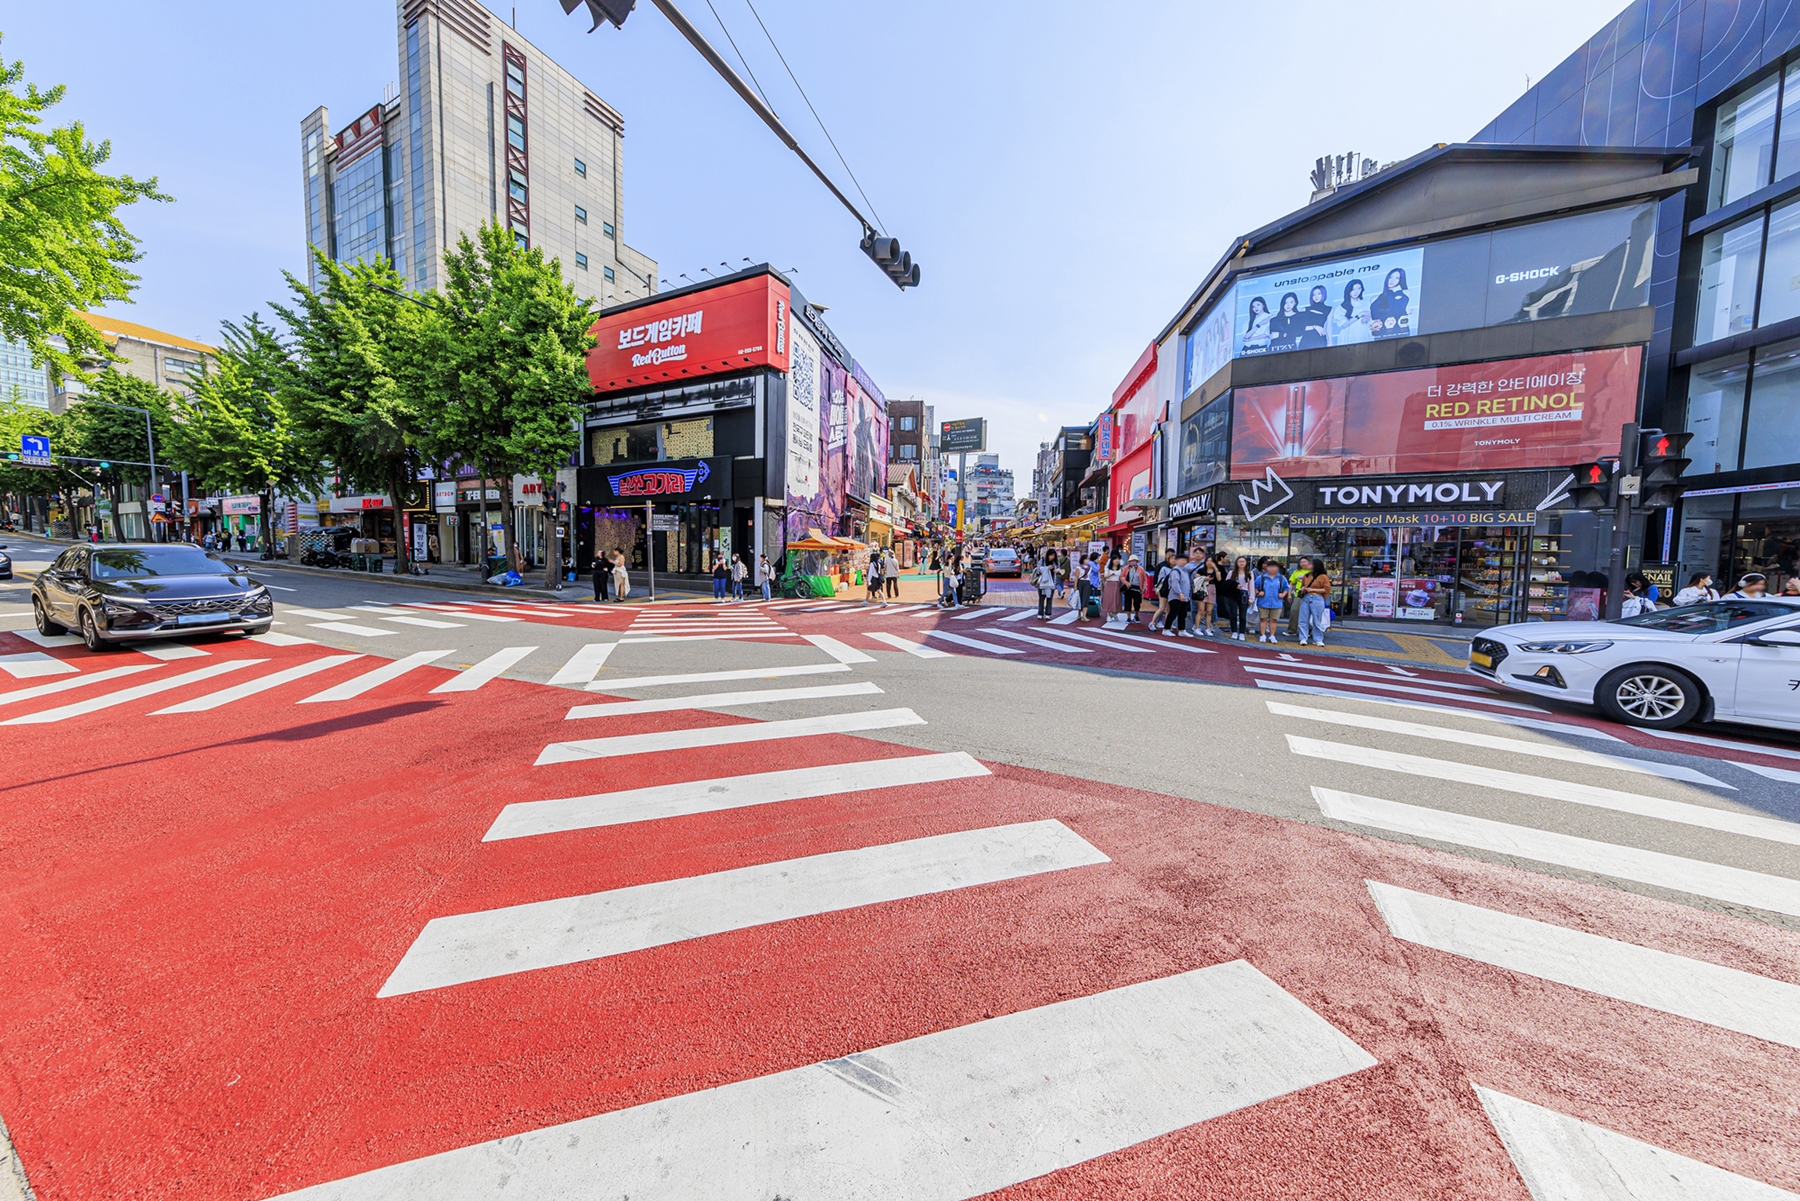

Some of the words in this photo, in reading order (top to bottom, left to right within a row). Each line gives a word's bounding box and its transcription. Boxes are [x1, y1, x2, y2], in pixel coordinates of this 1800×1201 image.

[1274, 268, 1355, 288] unstoppable
[1357, 263, 1381, 274] me
[1495, 266, 1560, 284] G-SHOCK
[617, 310, 704, 350] 보드게임카페
[1427, 384, 1442, 398] 더
[1446, 380, 1494, 397] 강력한
[1497, 371, 1583, 392] 안티에이징
[1425, 402, 1470, 418] RED
[1476, 392, 1583, 415] RETINOL
[1431, 420, 1452, 428] 0.1%
[1454, 417, 1498, 427] WRINKLE
[1500, 414, 1532, 424] MULTI
[1533, 411, 1572, 421] CREAM
[1474, 438, 1521, 446] TONYMOLY
[619, 472, 685, 496] 날쏘고가라
[1319, 481, 1504, 505] TONYMOLY
[1169, 493, 1210, 517] TONYMOLY
[1291, 514, 1319, 525] Snail
[1321, 514, 1382, 527] Hydro-gel
[1385, 514, 1419, 524] Mask
[1423, 513, 1466, 523] 10+10
[1469, 513, 1494, 523] BIG
[1497, 512, 1535, 523] SALE
